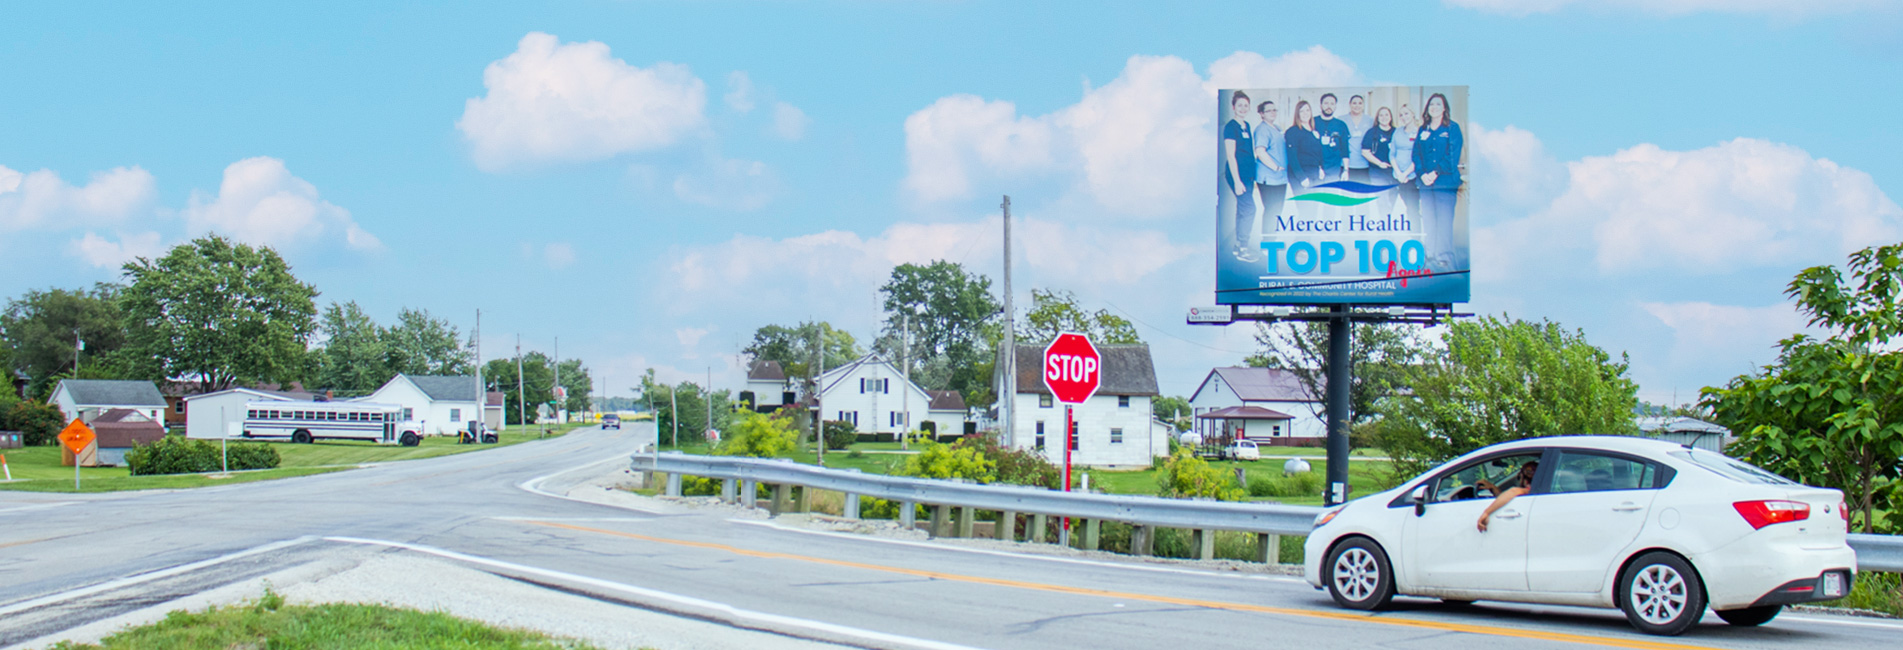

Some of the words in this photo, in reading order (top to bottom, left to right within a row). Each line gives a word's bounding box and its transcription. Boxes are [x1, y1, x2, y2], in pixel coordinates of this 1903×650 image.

[1275, 214, 1342, 232] Mercer
[1348, 213, 1411, 232] Health
[1260, 240, 1345, 274] TOP
[1354, 239, 1425, 274] 100
[1259, 281, 1287, 290] RURAL
[1298, 281, 1353, 290] COMMUNITY
[1354, 281, 1397, 290] HOSPITAL
[1386, 260, 1433, 288] Again
[1048, 353, 1097, 383] STOP
